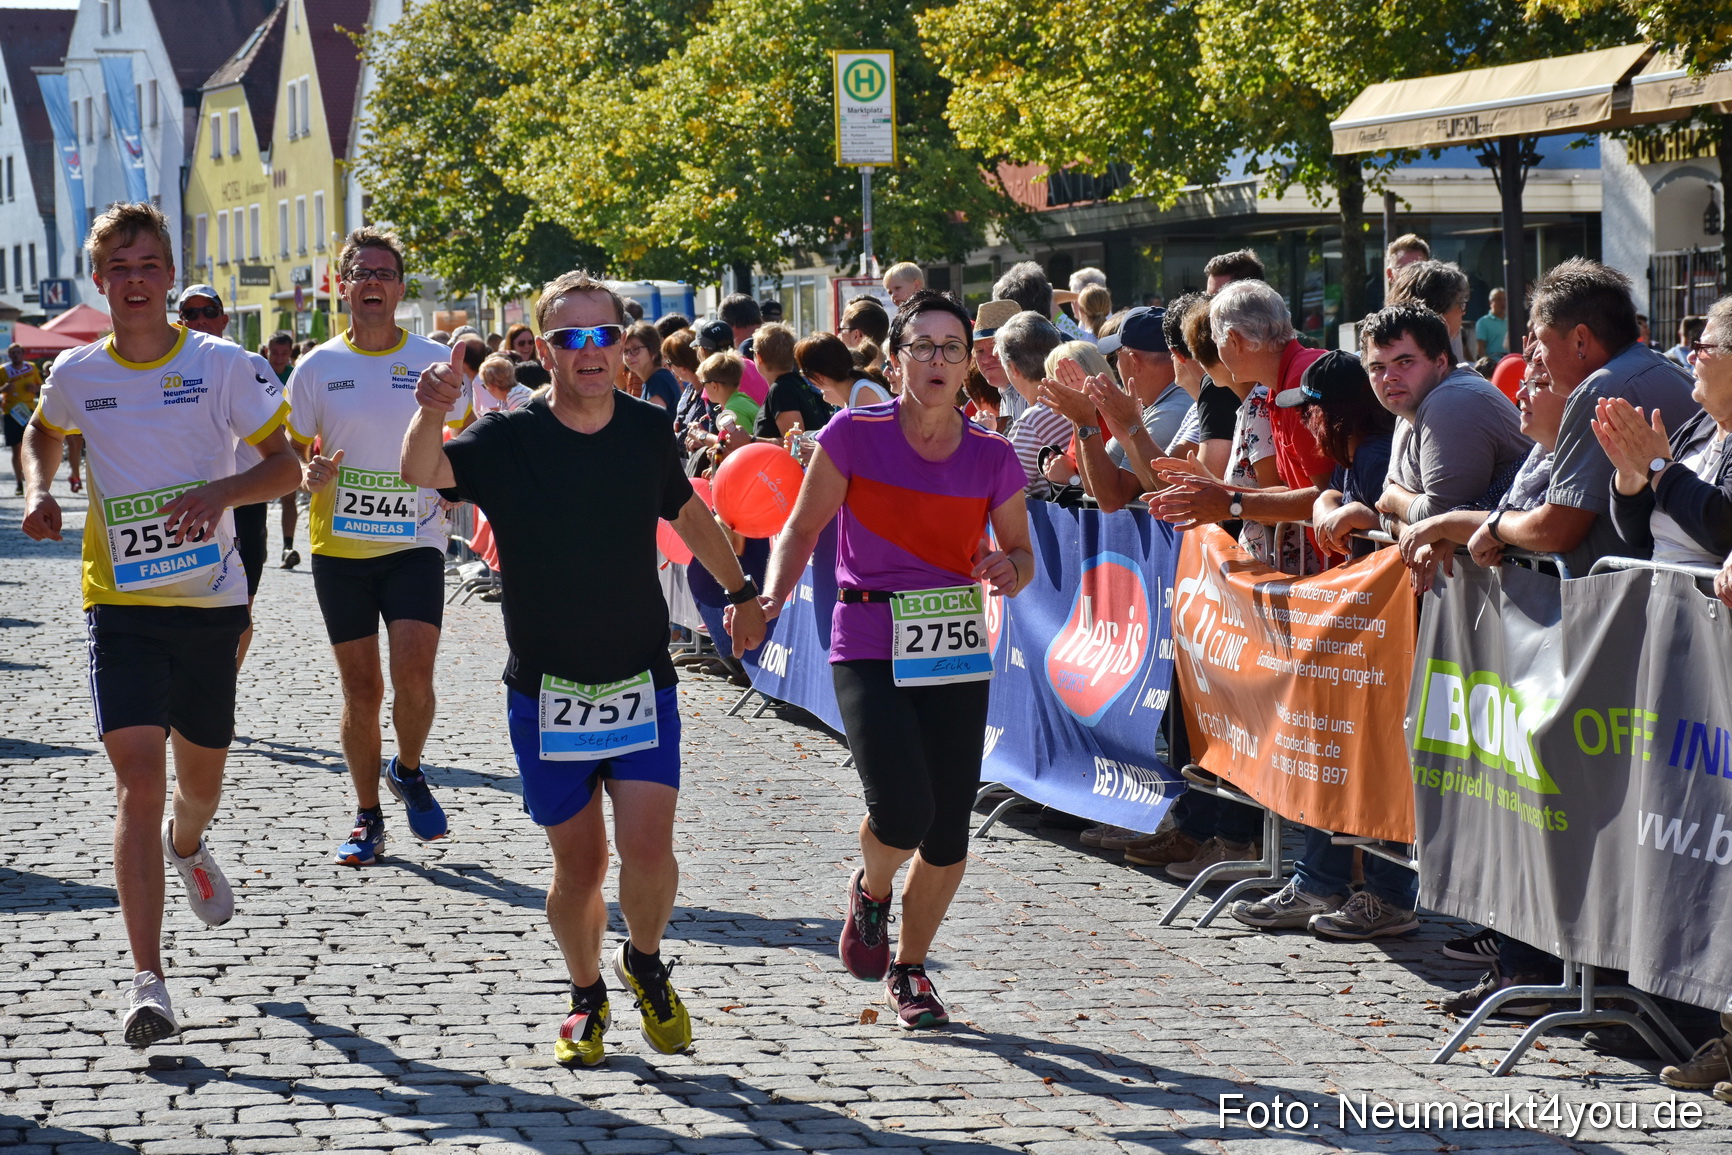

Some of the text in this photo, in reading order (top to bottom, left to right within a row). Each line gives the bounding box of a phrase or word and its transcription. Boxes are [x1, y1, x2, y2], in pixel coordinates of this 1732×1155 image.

[853, 69, 875, 92] H
[847, 107, 883, 115] Marktplatz
[222, 180, 241, 202] HOTEL
[163, 375, 182, 389] 20
[392, 365, 406, 376] 20
[163, 387, 209, 397] Neumarkter
[328, 380, 355, 390] BOCK
[85, 397, 117, 409] BOCK
[344, 471, 409, 489] BOCK
[343, 492, 408, 518] 2544
[344, 520, 404, 534] ANDREAS
[139, 553, 198, 578] FABIAN
[901, 592, 977, 616] BOCK
[1296, 584, 1338, 604] moderner
[906, 620, 979, 653] 2756
[1321, 610, 1387, 639] Umsetzung
[1055, 594, 1144, 687] Hervis
[1158, 638, 1175, 660] ONLI
[1208, 629, 1248, 672] CLINIC
[1297, 637, 1313, 652] was
[1315, 635, 1367, 659] Internet,
[932, 658, 971, 672] Erika
[1292, 658, 1340, 686] Werbung
[1342, 666, 1387, 689] angeht.
[1057, 669, 1088, 694] SPORTS
[554, 692, 642, 726] 2757
[1141, 687, 1170, 711] MOBI
[1292, 710, 1309, 728] sich
[1311, 711, 1328, 731] bei
[1330, 719, 1355, 734] uns:
[575, 733, 628, 748] Stefan
[1283, 733, 1341, 759] codeclinic.de
[1092, 755, 1118, 798] GET
[1298, 760, 1319, 782] 8833
[1321, 765, 1348, 785] 897
[1411, 757, 1482, 797] inspired
[1485, 773, 1494, 809] by
